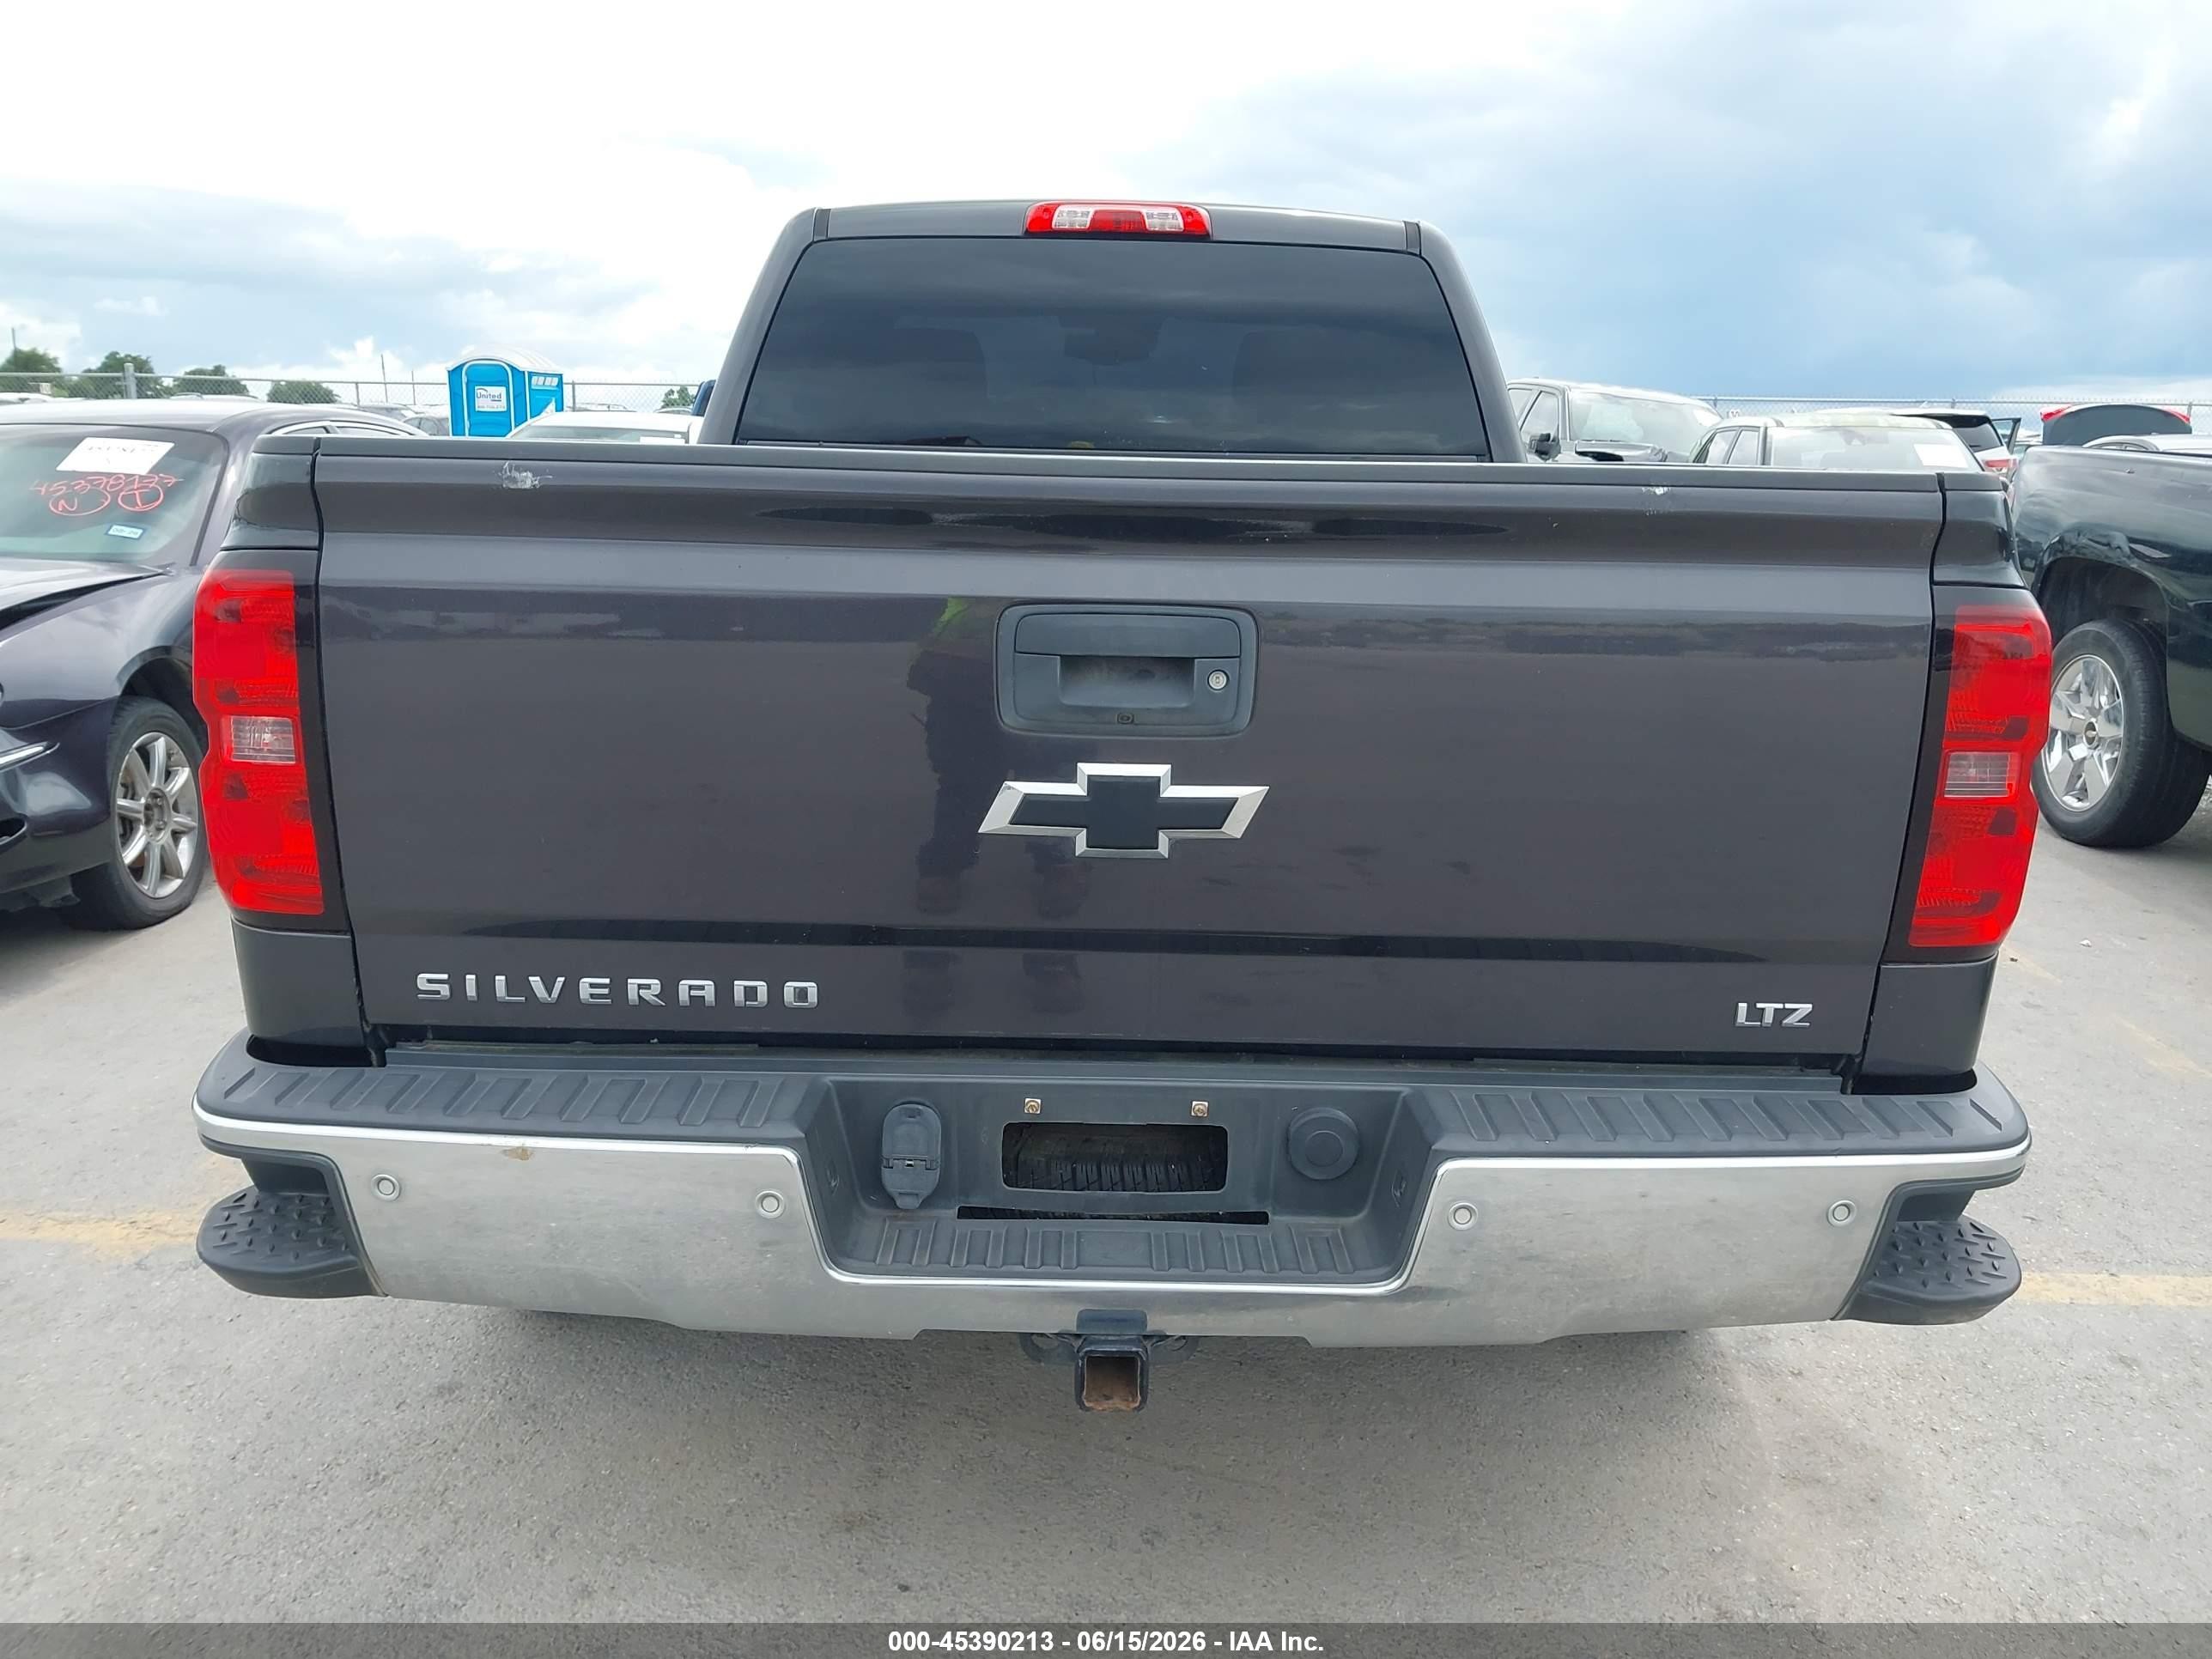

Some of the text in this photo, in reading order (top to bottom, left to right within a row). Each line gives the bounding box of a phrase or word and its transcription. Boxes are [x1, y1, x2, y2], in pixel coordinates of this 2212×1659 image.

[58, 498, 78, 511] N
[416, 973, 818, 1009] SILVERADO
[1735, 1002, 1813, 1027] LTZ
